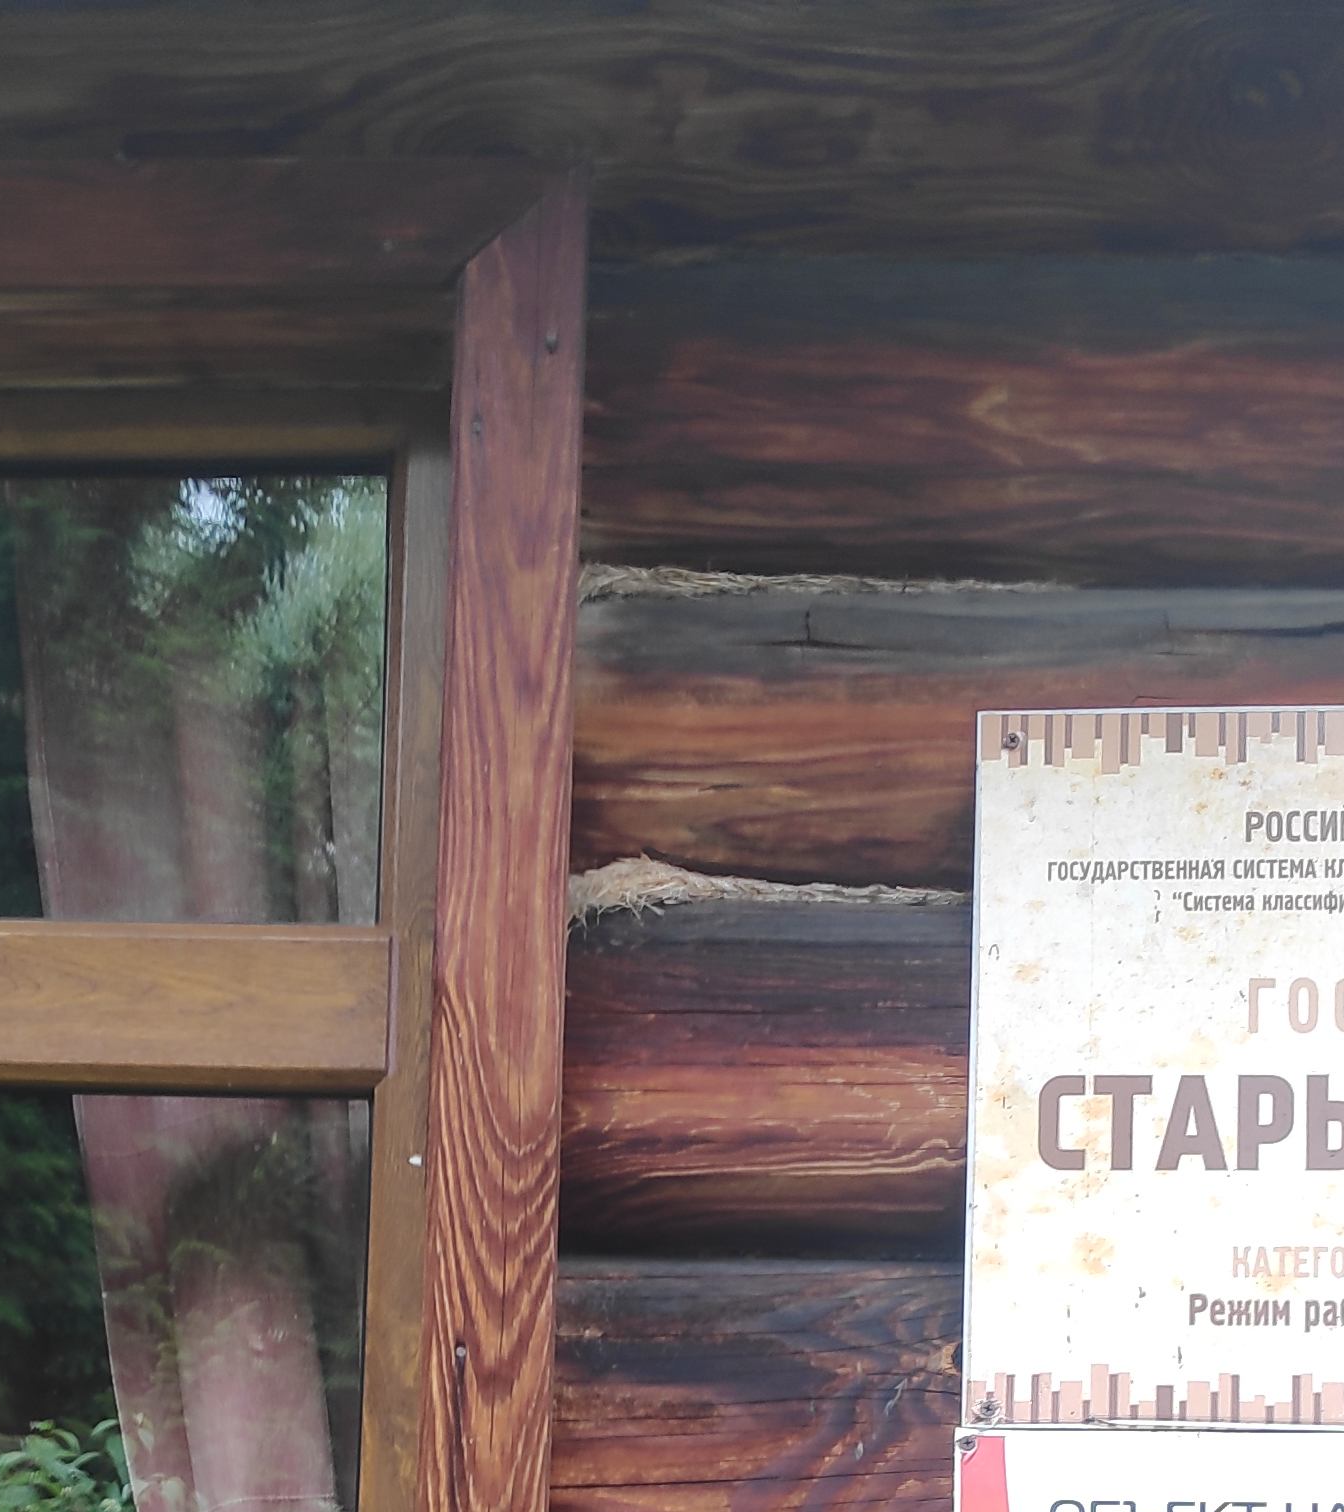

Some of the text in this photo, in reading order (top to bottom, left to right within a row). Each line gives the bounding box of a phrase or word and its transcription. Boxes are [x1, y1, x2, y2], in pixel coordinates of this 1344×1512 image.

[1047, 857, 1225, 884] ГОСУДАРСТВЕННАЯ
[1232, 856, 1317, 879] СИСТЕМА
[1188, 1295, 1291, 1327] Режим
